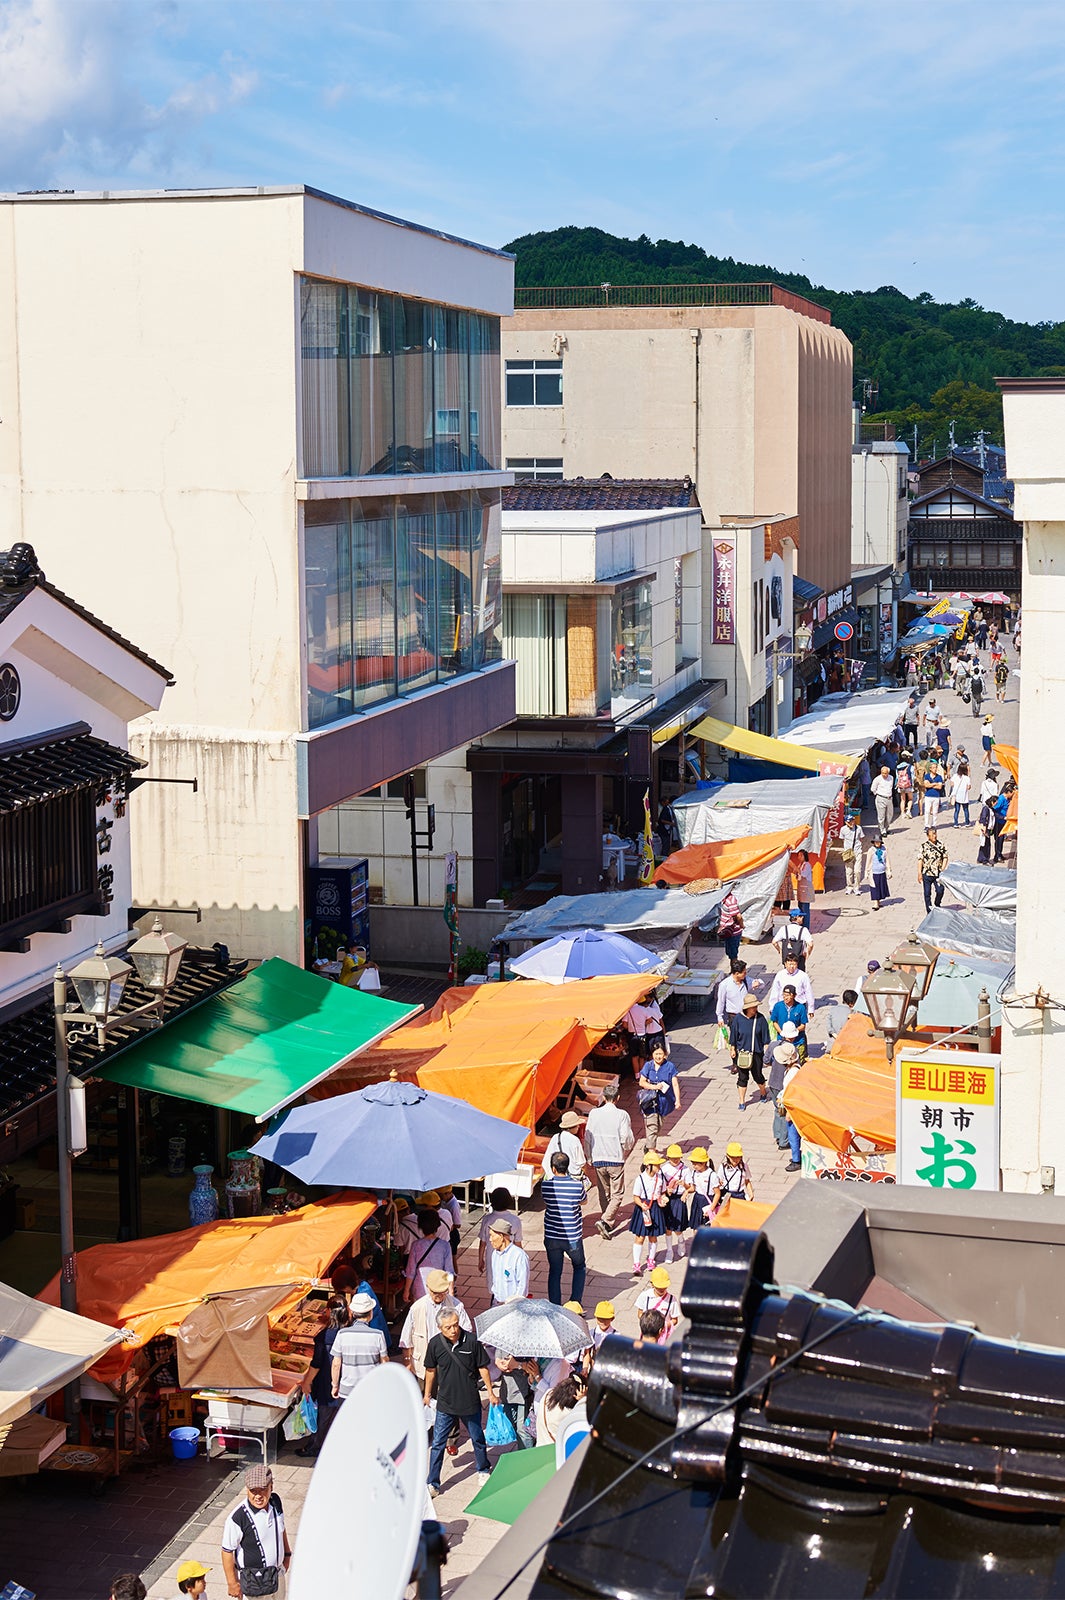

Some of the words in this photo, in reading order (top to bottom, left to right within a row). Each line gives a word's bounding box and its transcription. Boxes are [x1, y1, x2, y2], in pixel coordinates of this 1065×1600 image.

[716, 555, 732, 641] 永井洋服店
[315, 906, 341, 916] BOSS
[907, 1067, 987, 1095] 里山里海
[920, 1105, 974, 1132] 朝市
[915, 1131, 977, 1191] お
